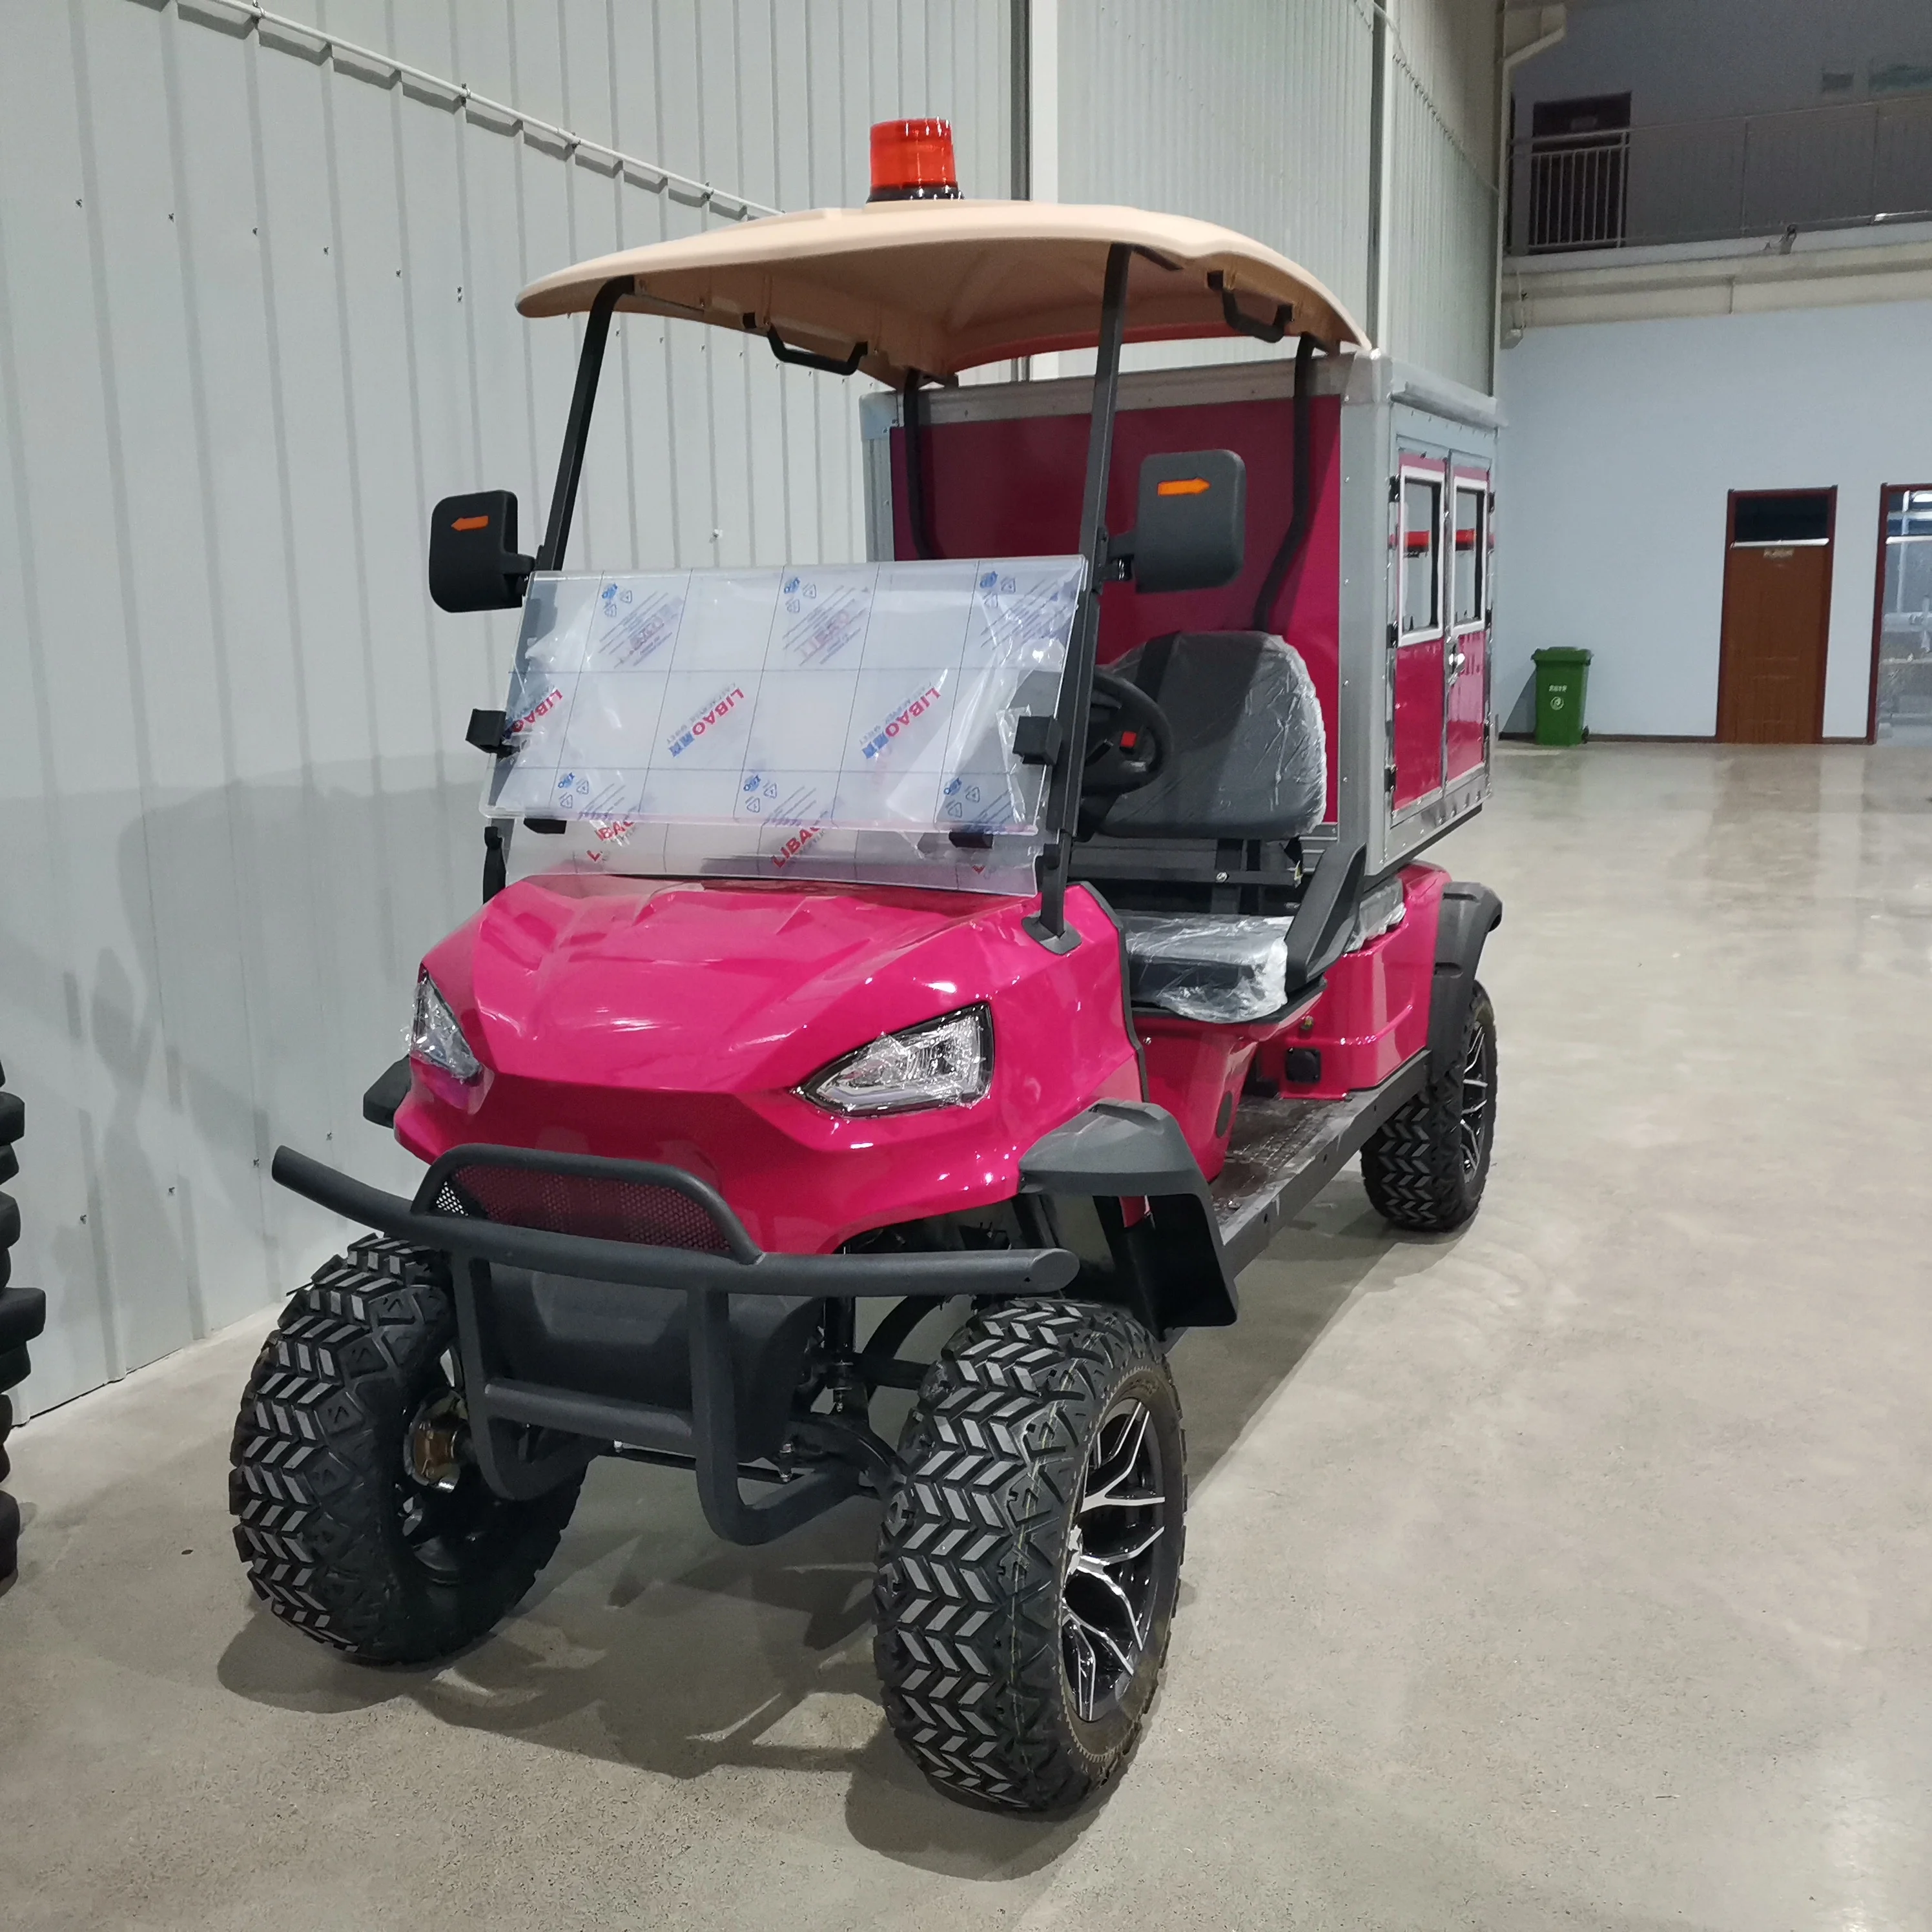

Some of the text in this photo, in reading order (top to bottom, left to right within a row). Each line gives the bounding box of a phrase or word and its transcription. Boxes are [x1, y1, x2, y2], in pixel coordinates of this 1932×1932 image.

[513, 690, 563, 732] LIBAO
[692, 688, 744, 735] LIBAO
[885, 687, 941, 737] LIBAO
[586, 821, 635, 861] LIBA
